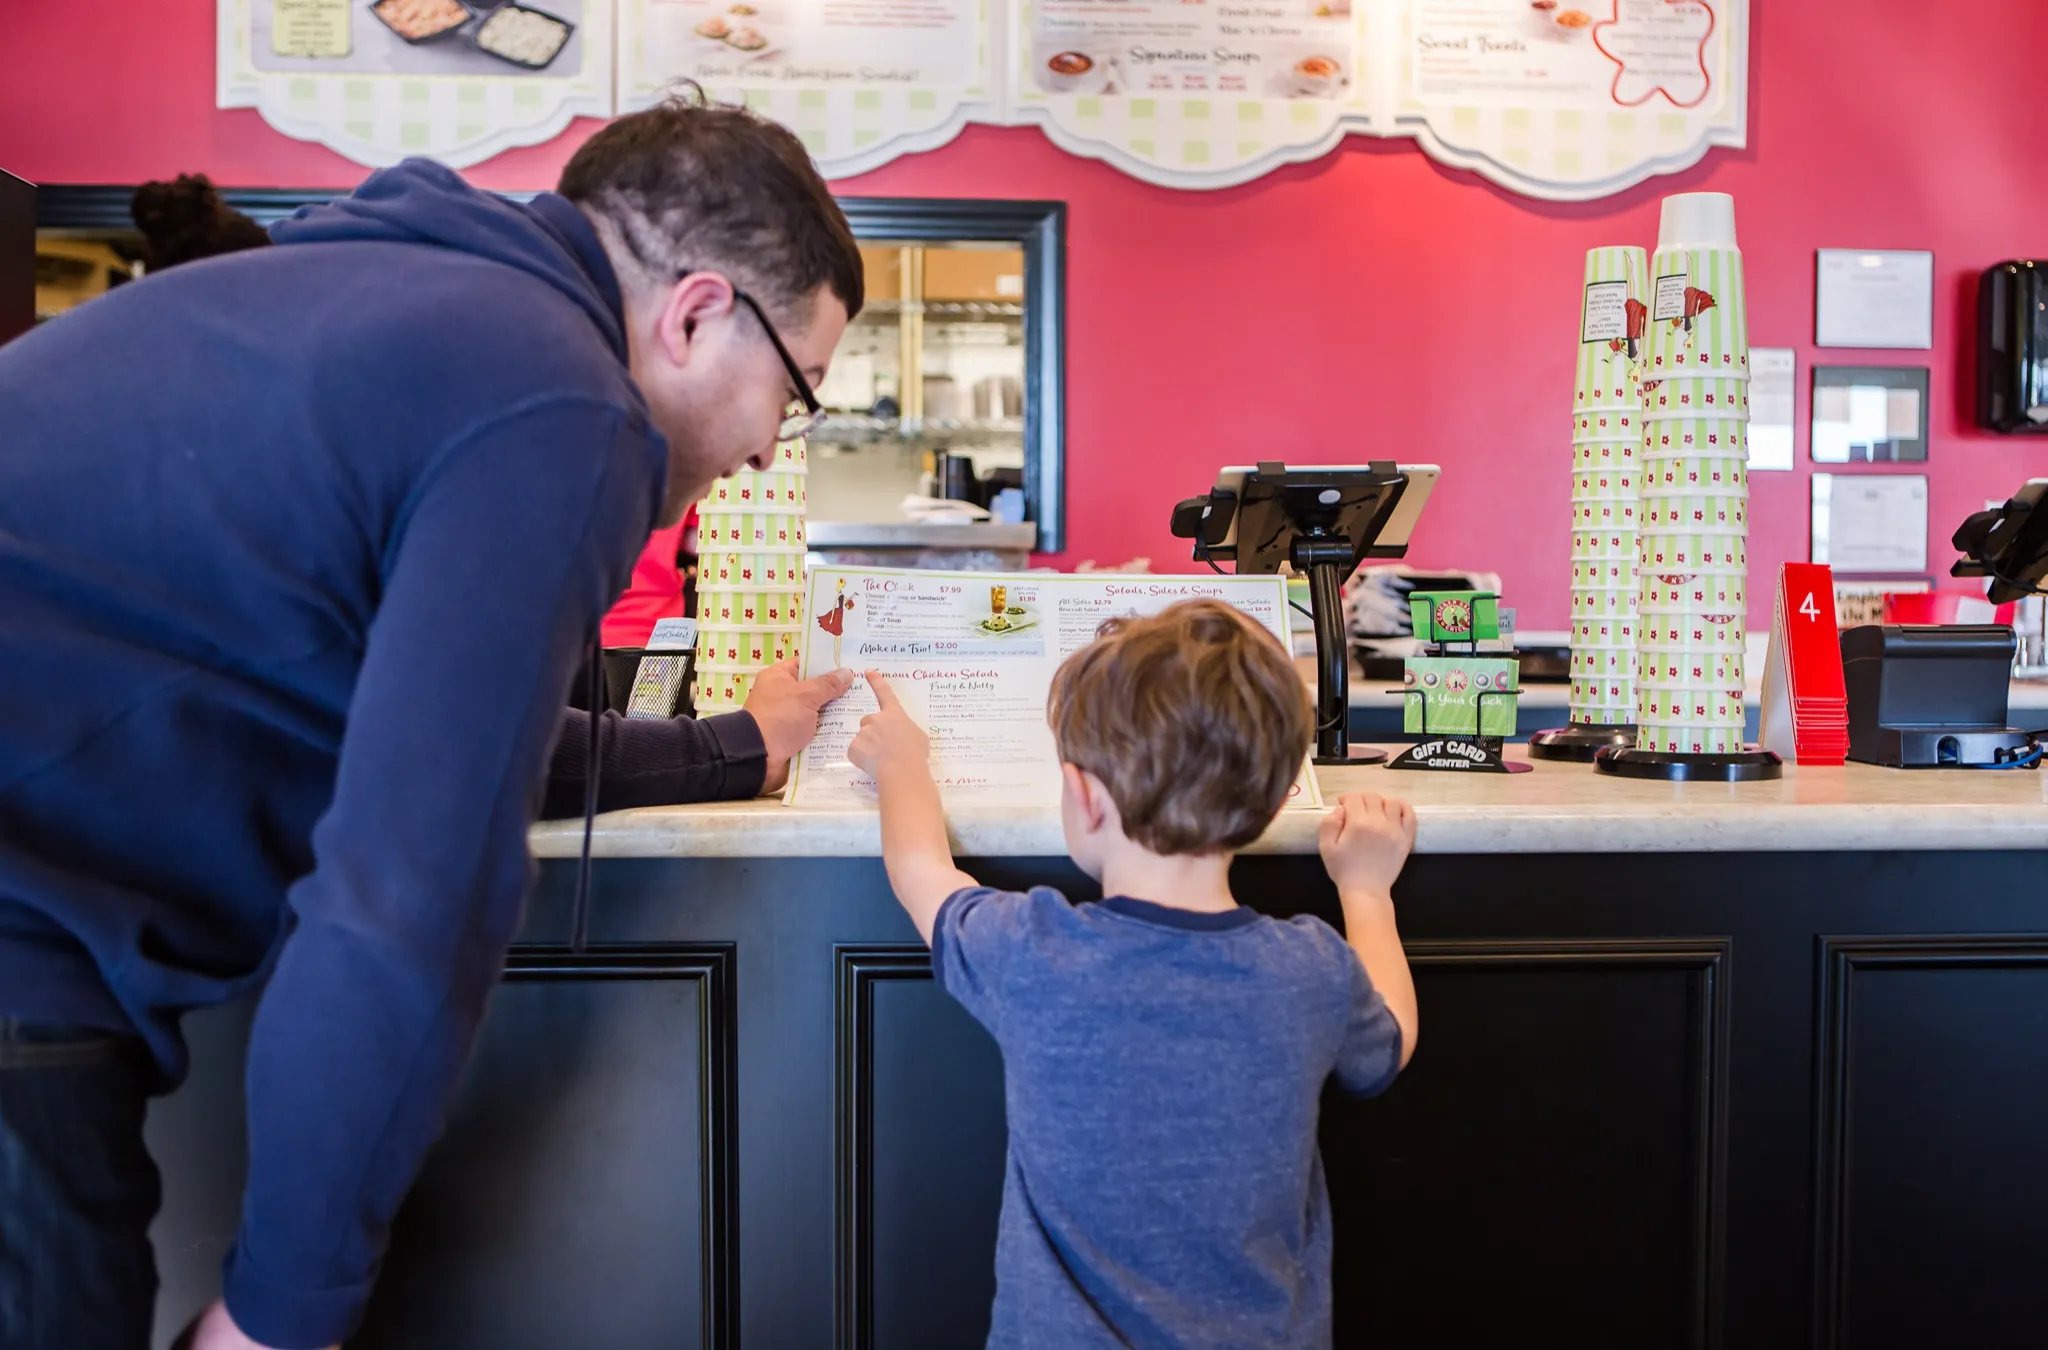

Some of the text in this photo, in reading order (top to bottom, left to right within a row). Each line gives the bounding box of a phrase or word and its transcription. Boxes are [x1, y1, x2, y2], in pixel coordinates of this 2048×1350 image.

[1130, 45, 1260, 65] Signature Soups
[863, 578, 880, 591] The
[1105, 585, 1223, 596] Salads, Sides & Soups
[1436, 600, 1457, 621] CHICKEN
[1799, 592, 1821, 622] 4
[1445, 624, 1469, 633] CHICK
[860, 643, 888, 654] Make
[891, 644, 898, 652] it
[908, 643, 931, 654] Trio!
[875, 668, 909, 678] mous
[912, 669, 956, 680] Chicken
[960, 669, 998, 680] Salads
[929, 682, 956, 691] Fruity
[968, 682, 995, 690] Nutty
[1409, 694, 1435, 706] Pk
[1438, 694, 1465, 706] Your
[929, 726, 953, 734] Spicy
[1412, 741, 1487, 762] GIFT CARD
[1428, 758, 1470, 768] CENTER
